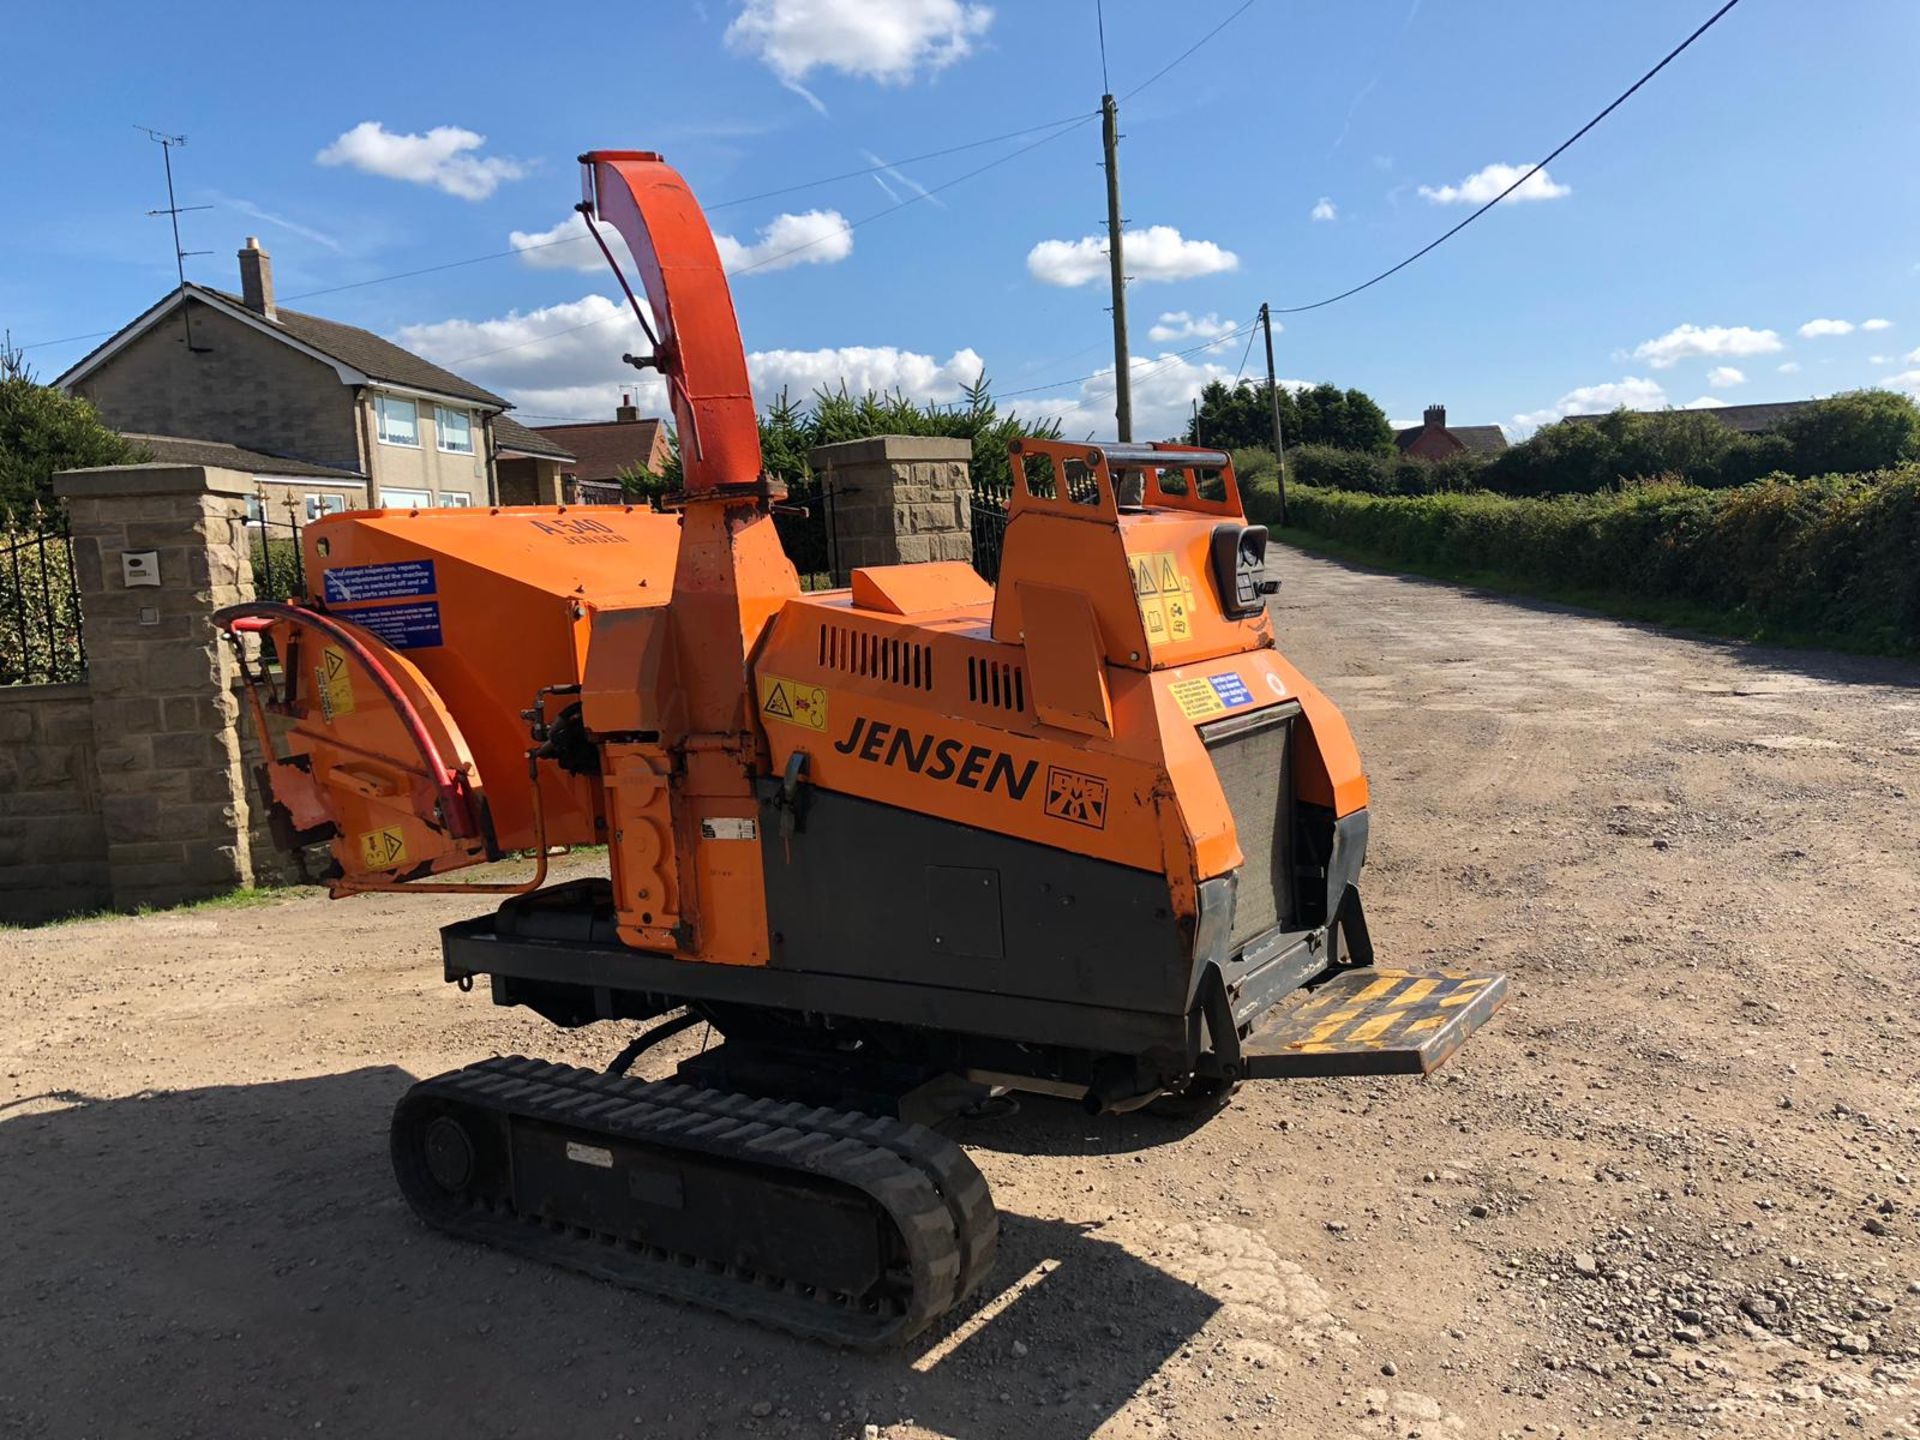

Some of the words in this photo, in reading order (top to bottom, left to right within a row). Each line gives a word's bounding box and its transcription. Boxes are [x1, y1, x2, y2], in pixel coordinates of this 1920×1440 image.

[530, 520, 565, 535] A
[552, 519, 613, 534] 540
[564, 535, 629, 545] JENSEN
[370, 581, 396, 589] switched
[389, 587, 419, 596] stationary
[834, 717, 1039, 801] JENSEN
